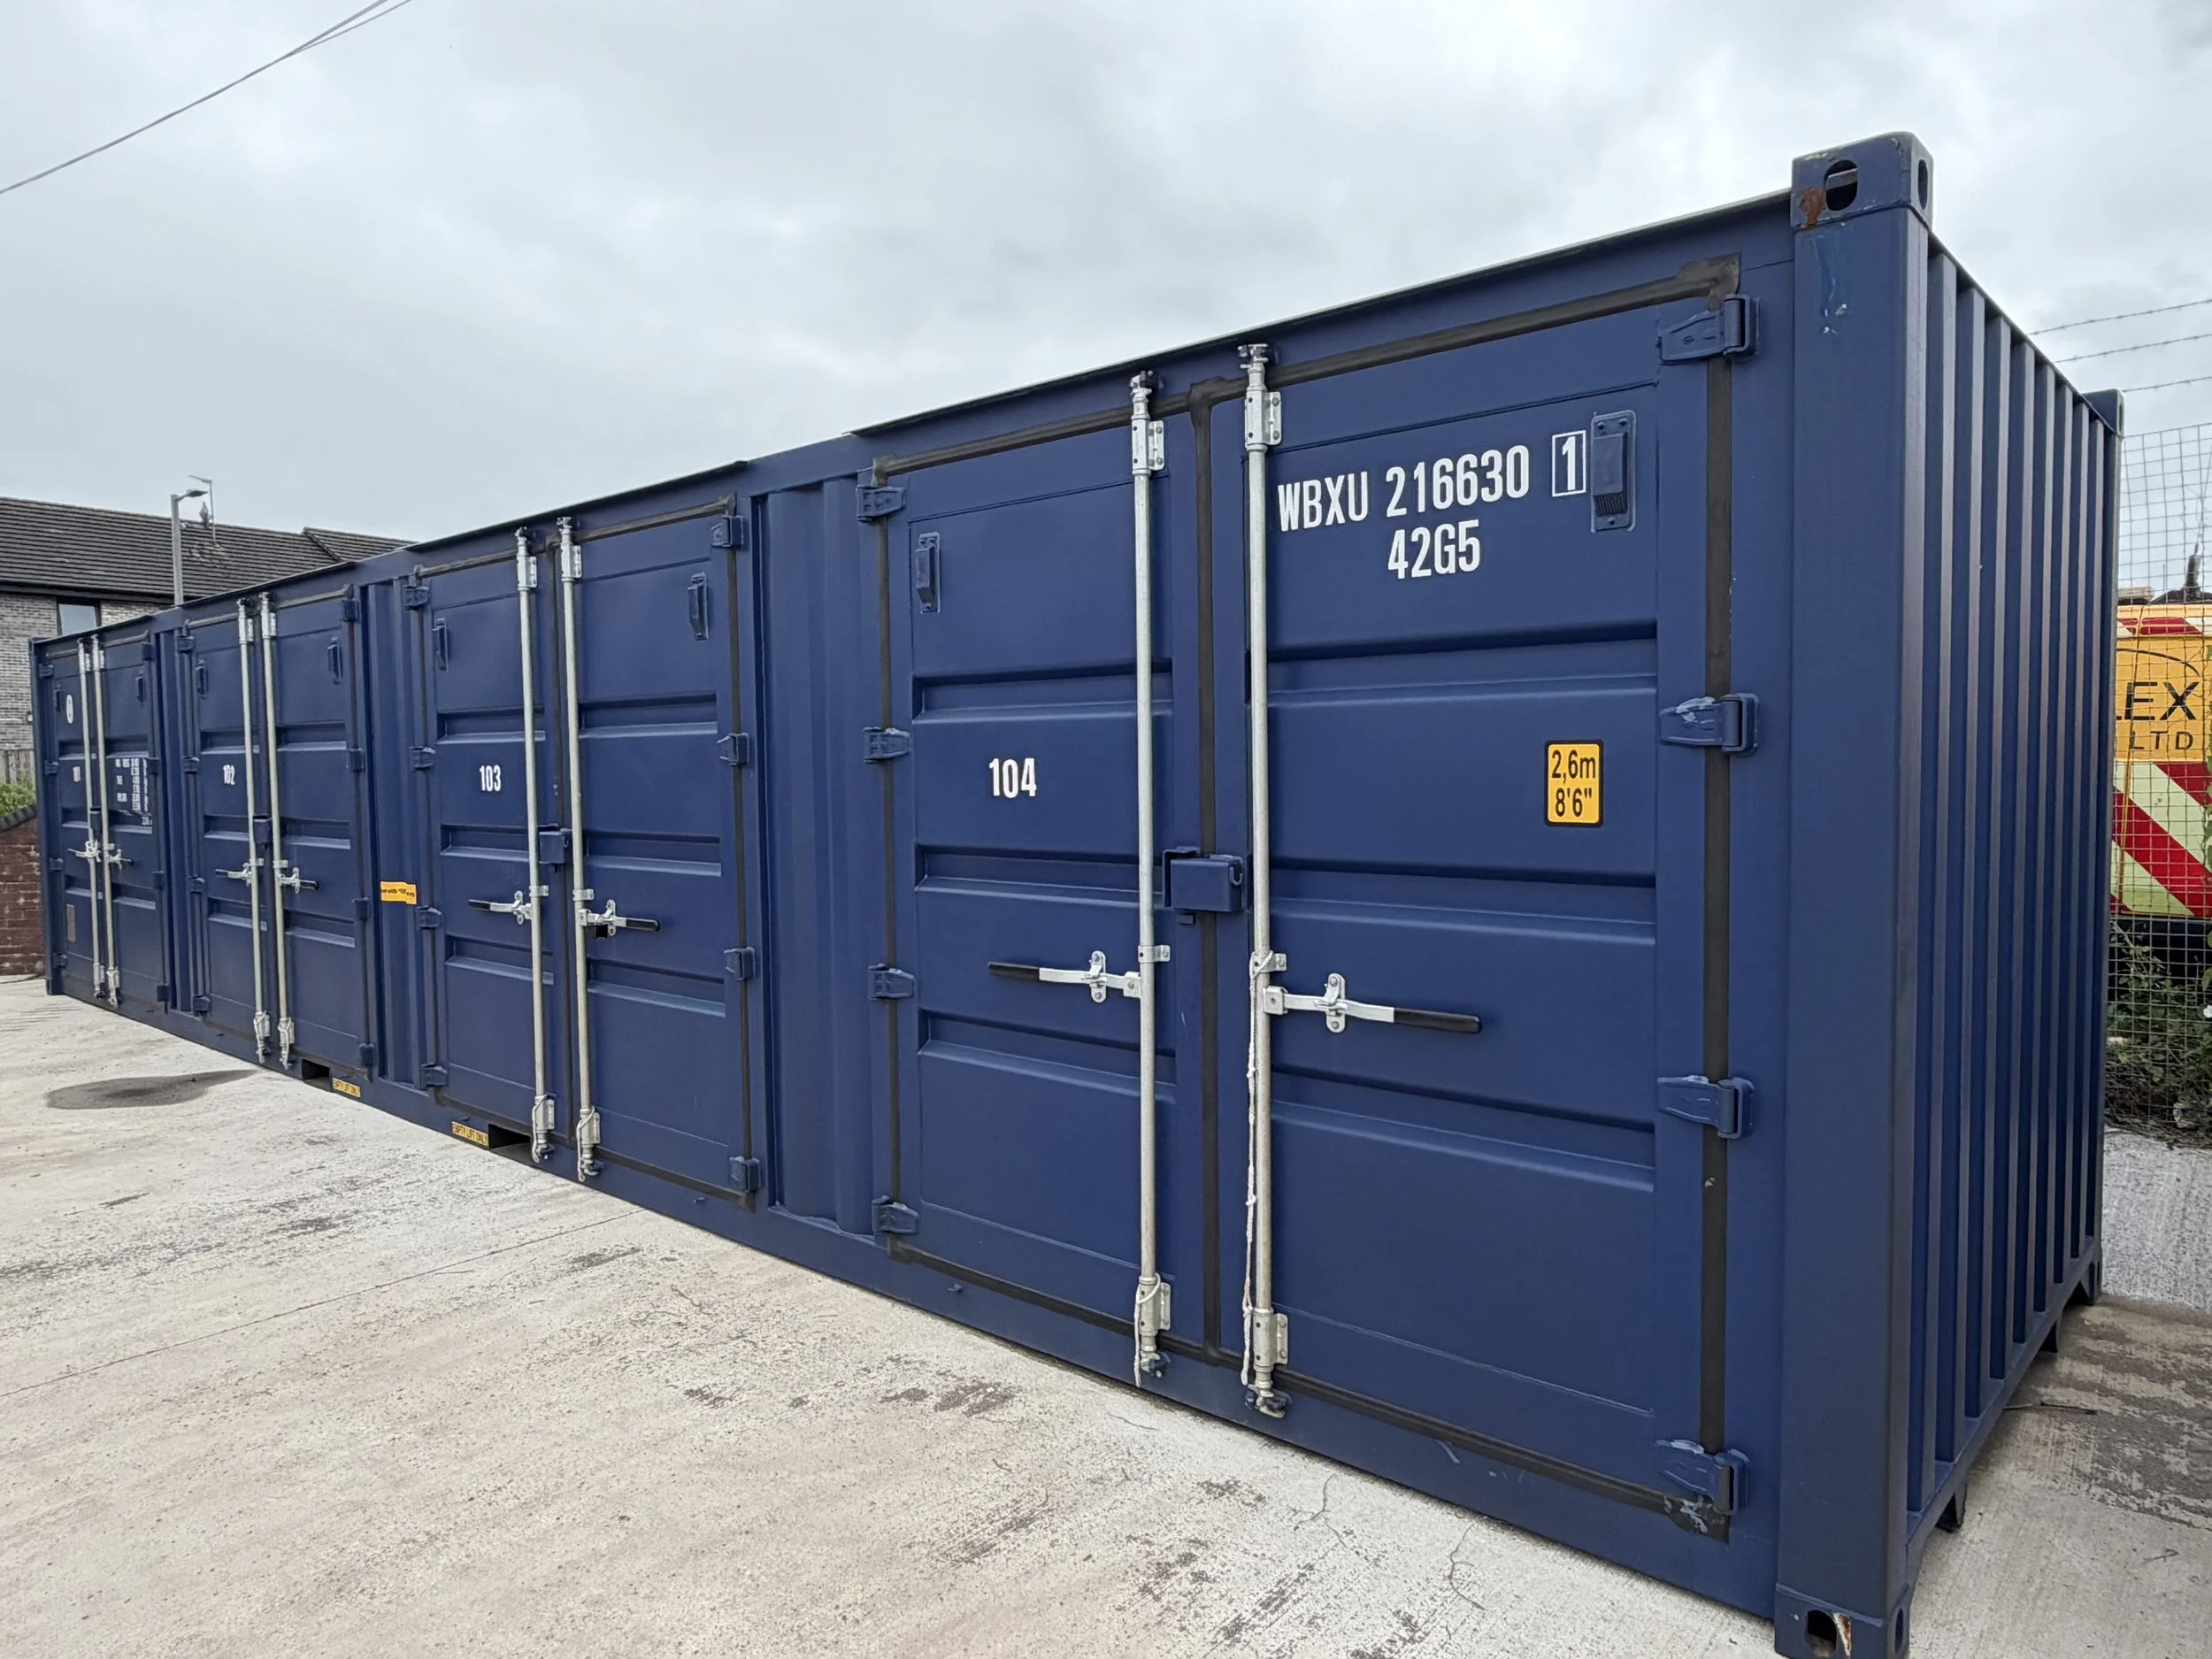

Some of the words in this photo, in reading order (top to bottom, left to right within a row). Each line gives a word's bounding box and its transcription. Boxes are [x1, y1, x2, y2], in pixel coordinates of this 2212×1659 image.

[1278, 472, 1368, 532] WBXU
[1386, 445, 1529, 518] 216630
[1562, 436, 1577, 491] 1
[1387, 519, 1481, 580] 42G5
[2116, 682, 2200, 720] EX
[2131, 730, 2194, 750] LTD
[223, 764, 235, 786] 102
[479, 764, 502, 792] 103
[988, 757, 1037, 799] 104
[1551, 749, 1595, 785] 2,6m
[1555, 787, 1592, 818] 8'6"
